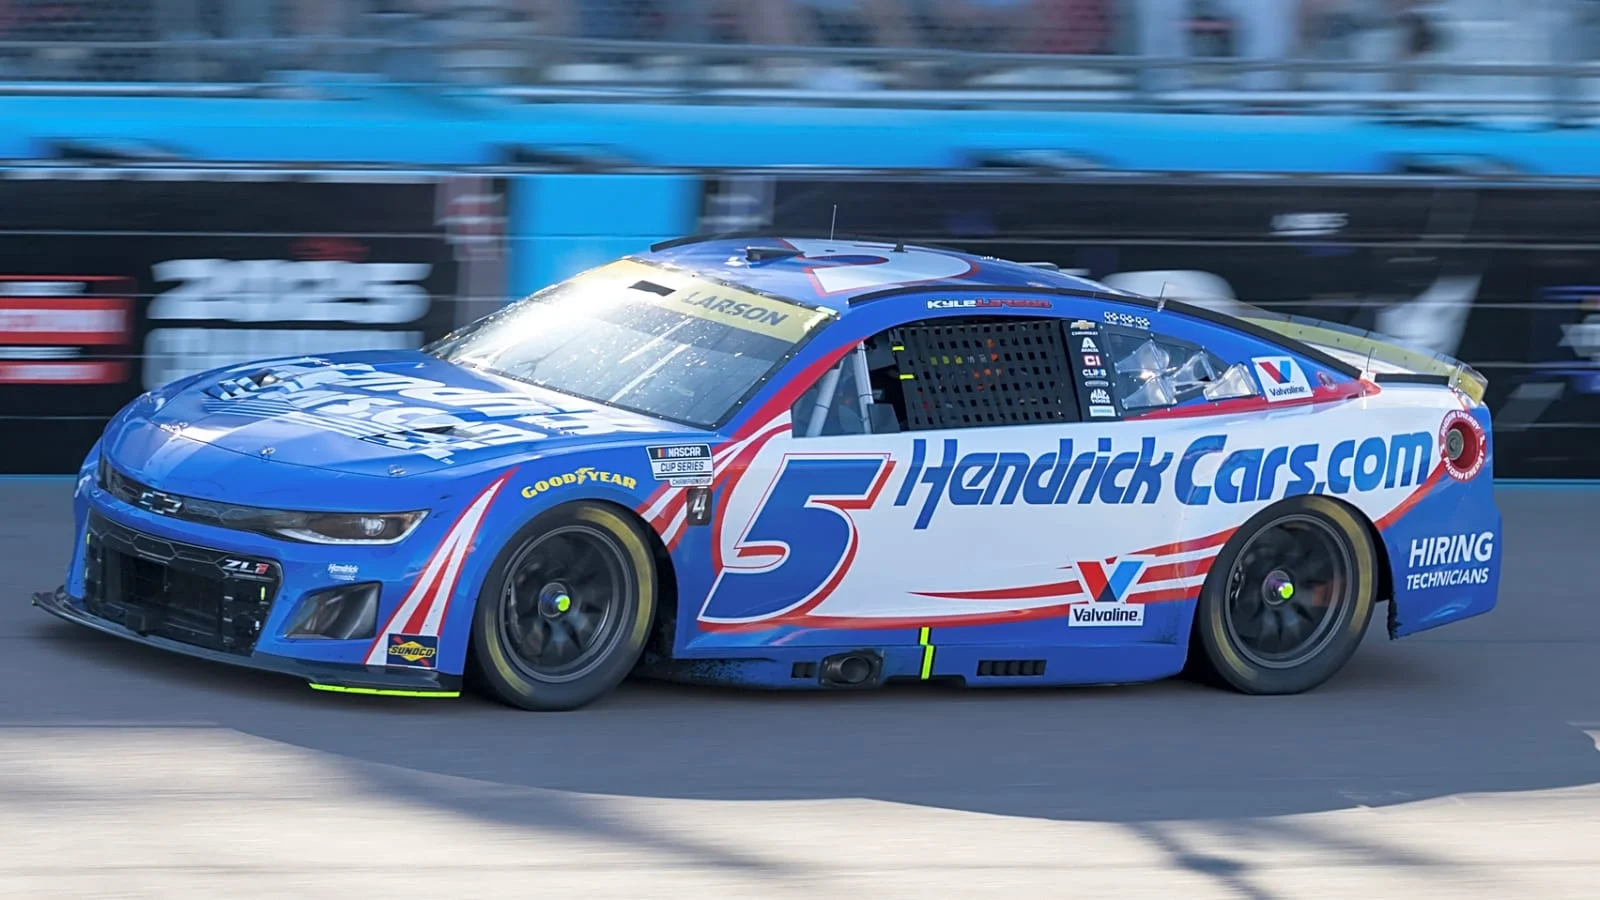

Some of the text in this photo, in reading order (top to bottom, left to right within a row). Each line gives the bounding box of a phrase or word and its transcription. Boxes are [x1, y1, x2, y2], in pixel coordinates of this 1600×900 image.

[681, 291, 788, 327] LARSON
[1269, 386, 1305, 397] Valvoline
[669, 447, 702, 458] NASCAR
[661, 461, 704, 472] CUP SERIES
[521, 467, 637, 499] GOODYEAR
[692, 491, 707, 520] 4
[697, 453, 896, 626] 5
[1408, 531, 1494, 568] HIRING
[222, 559, 270, 574] ZL1
[1406, 568, 1489, 590] TECHNICIANS
[1073, 607, 1138, 622] Valvoline
[390, 646, 434, 656] SUNOCO
